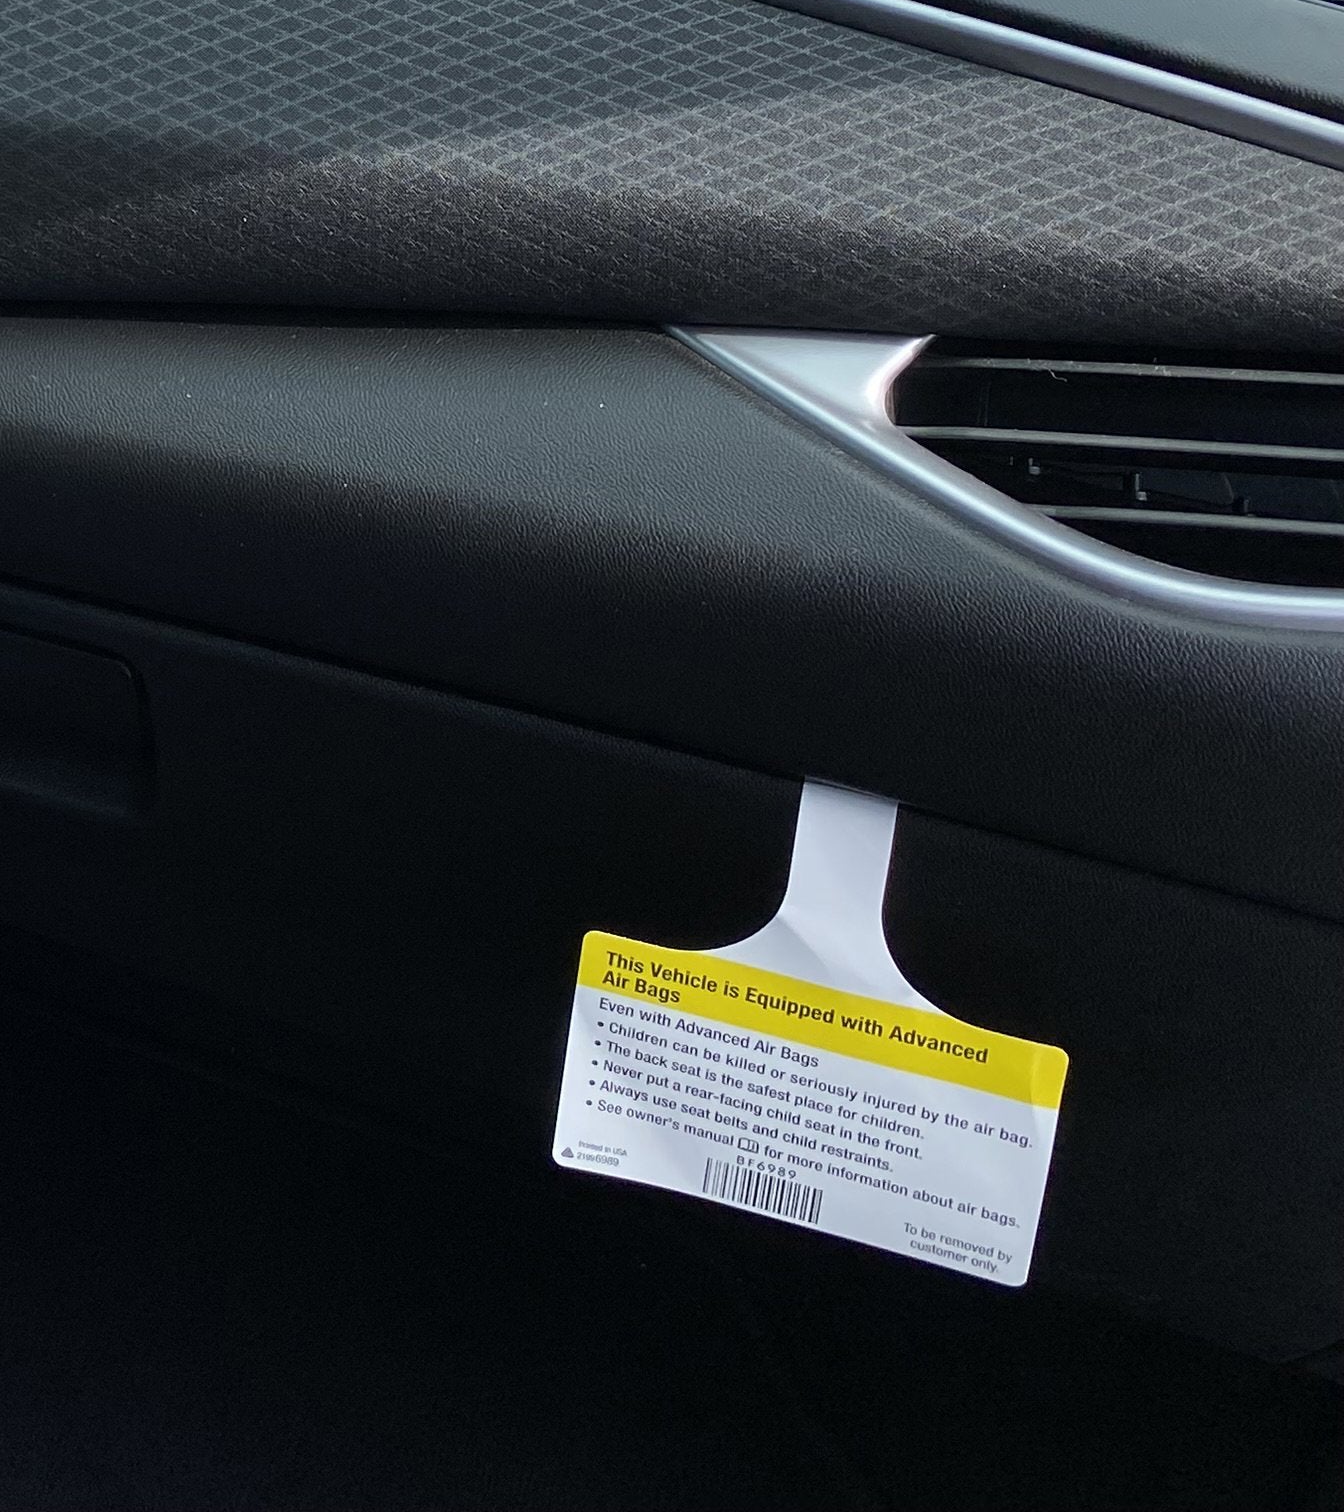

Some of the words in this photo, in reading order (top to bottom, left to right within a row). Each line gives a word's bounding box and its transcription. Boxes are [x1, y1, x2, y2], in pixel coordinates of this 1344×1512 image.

[599, 997, 634, 1017] Even
[639, 1009, 671, 1028] with
[675, 1018, 750, 1049] Advanced
[753, 1039, 776, 1056] Air
[780, 1046, 819, 1068] Bags
[602, 970, 630, 989] Air
[634, 978, 681, 1003] Bags
[606, 951, 644, 974] This
[651, 962, 717, 993] Vehicle
[723, 981, 739, 998] is
[745, 986, 835, 1024] Equipped
[841, 1015, 884, 1037] with
[889, 1025, 989, 1064] Advanced
[599, 1079, 649, 1102] Always
[652, 1095, 677, 1110] use
[681, 1101, 711, 1120] seat
[714, 1110, 749, 1131] belts
[752, 1123, 779, 1139] and
[782, 1131, 817, 1150] child
[820, 1143, 894, 1173] restraints.
[603, 1060, 644, 1081] Never
[646, 1073, 669, 1089] put
[672, 1081, 681, 1092] a
[685, 1084, 763, 1117] rear-facing
[766, 1107, 801, 1126] child
[804, 1119, 836, 1136] seat
[839, 1126, 852, 1140] in
[857, 1131, 880, 1148] the
[885, 1139, 923, 1161] front.
[606, 1040, 631, 1057] The
[635, 1049, 667, 1068] back
[671, 1059, 701, 1078] seat
[705, 1068, 717, 1082] is
[721, 1073, 744, 1089] the
[747, 1082, 791, 1103] safest
[794, 1094, 833, 1115] place
[838, 1105, 858, 1120] for
[862, 1113, 924, 1139] children.
[609, 1021, 668, 1048] Children
[672, 1041, 698, 1056] can
[703, 1048, 721, 1062] be
[726, 1054, 766, 1075] killed
[770, 1068, 786, 1080] or
[790, 1073, 858, 1102] seriously
[863, 1091, 916, 1115] injured
[921, 1106, 939, 1124] by
[944, 1113, 969, 1130] the
[974, 1120, 995, 1137] air
[999, 1128, 1033, 1148] bag.
[597, 1099, 622, 1116] See
[626, 1107, 680, 1131] owner's
[684, 1123, 734, 1147] manual
[764, 1144, 784, 1161] for
[787, 1153, 824, 1172] more
[827, 1162, 909, 1197] information
[912, 1189, 954, 1210] about
[957, 1201, 977, 1216] air
[981, 1206, 1021, 1229] bags.
[612, 1147, 628, 1157] USA
[904, 1222, 918, 1236] To
[921, 1228, 937, 1241] be
[940, 1234, 995, 1259] removed
[997, 1249, 1013, 1264] by
[910, 1239, 969, 1264] customer
[971, 1258, 999, 1274] only.
